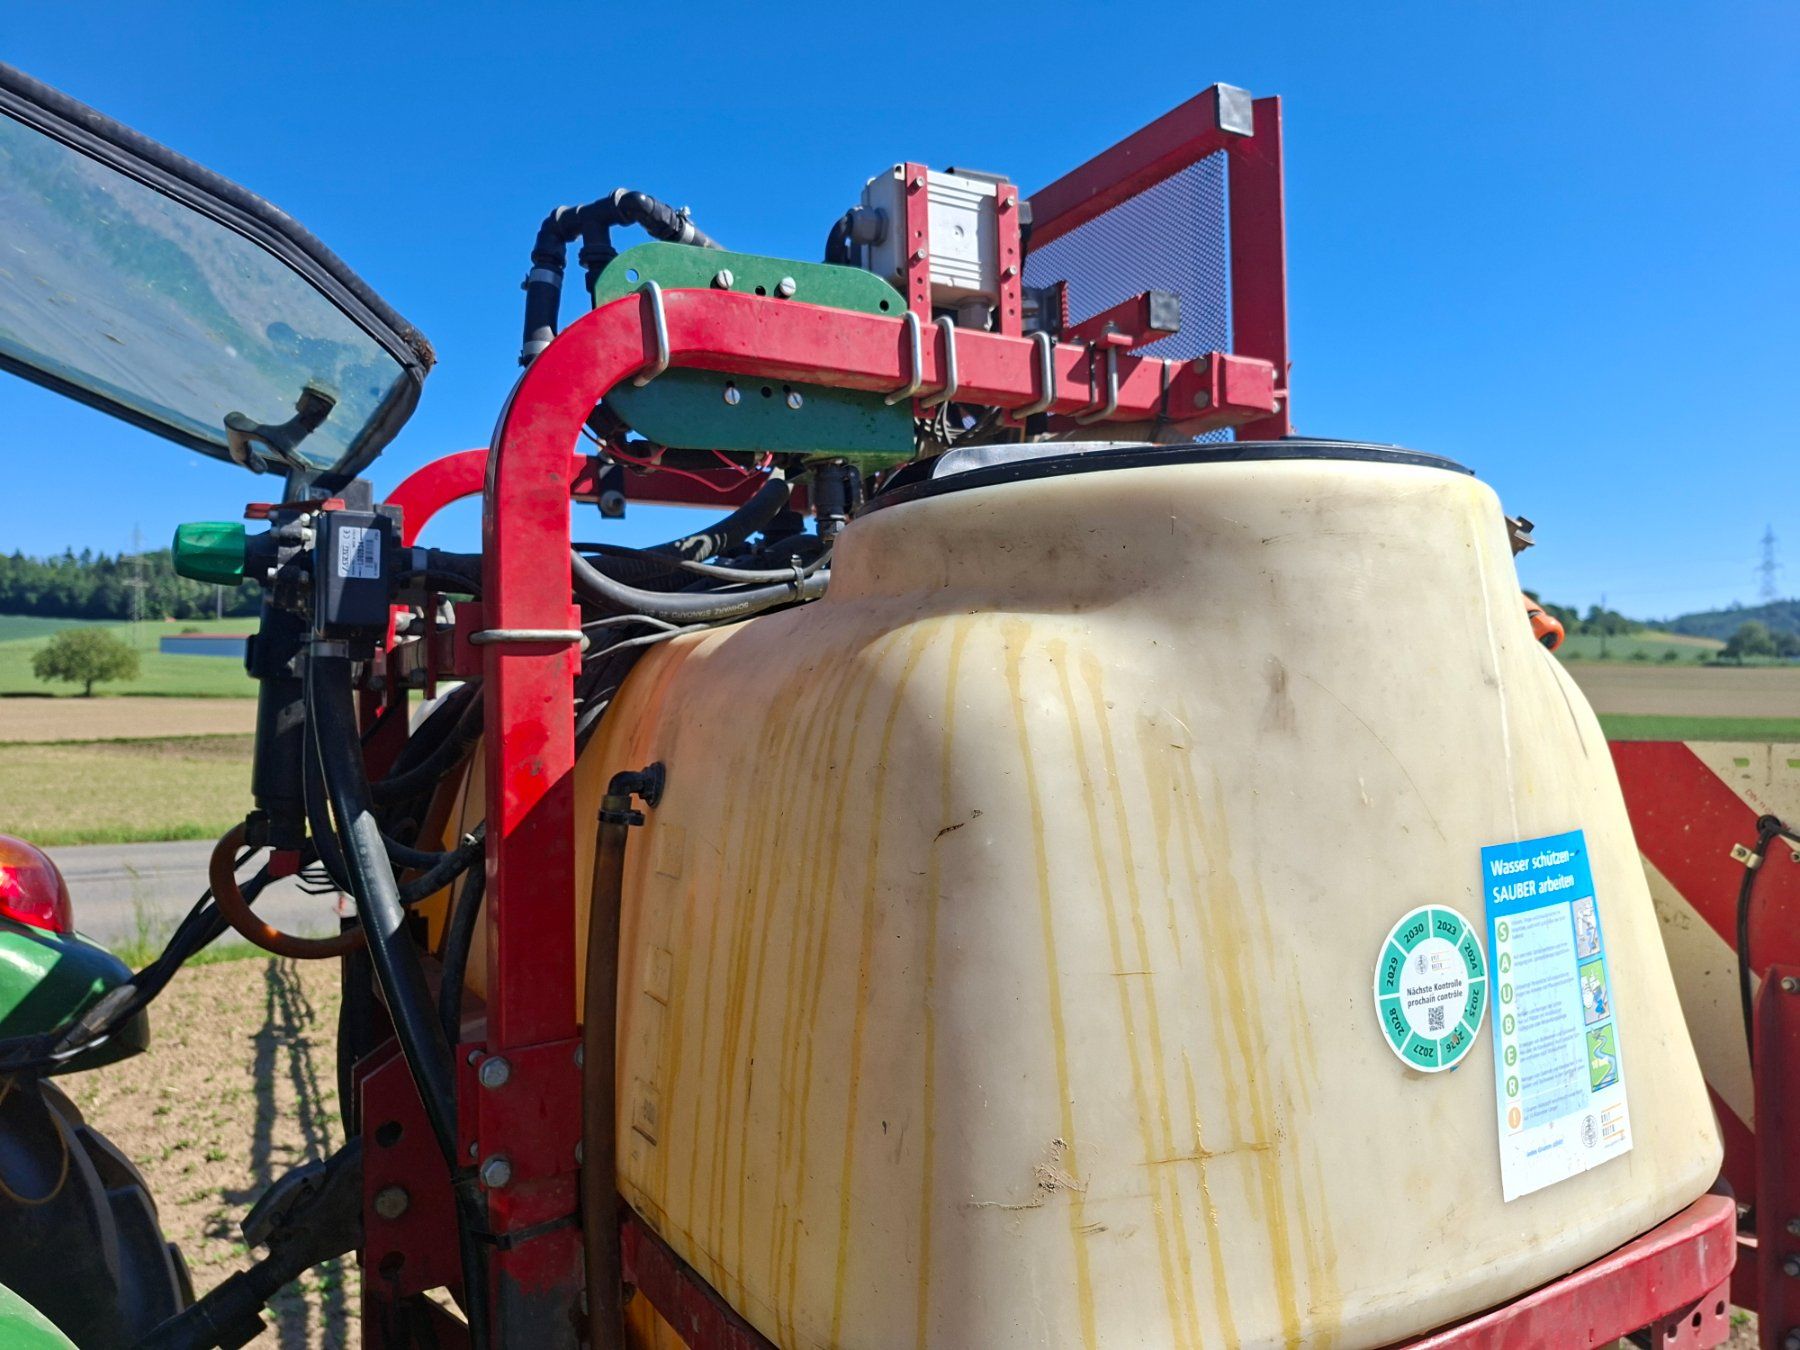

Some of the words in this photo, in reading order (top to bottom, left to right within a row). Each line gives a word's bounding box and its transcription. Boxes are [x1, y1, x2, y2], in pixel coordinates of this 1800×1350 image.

[671, 609, 712, 619] STANDARD
[1490, 858, 1529, 877] Wasser
[1492, 879, 1537, 904] SAUBER
[1538, 873, 1575, 894] arbeiten
[1403, 923, 1425, 944] 2030
[1437, 919, 1457, 936] 2023
[1463, 943, 1478, 971] 2024
[1386, 957, 1399, 987] 2029
[1406, 982, 1433, 997] Nächste
[1433, 978, 1462, 992] Kontrolle
[1407, 993, 1436, 1009] prochain
[1436, 989, 1463, 1003] contrôle
[1468, 988, 1480, 1017] 2025
[1389, 1007, 1405, 1036] 2028
[1412, 1043, 1434, 1058] 2027
